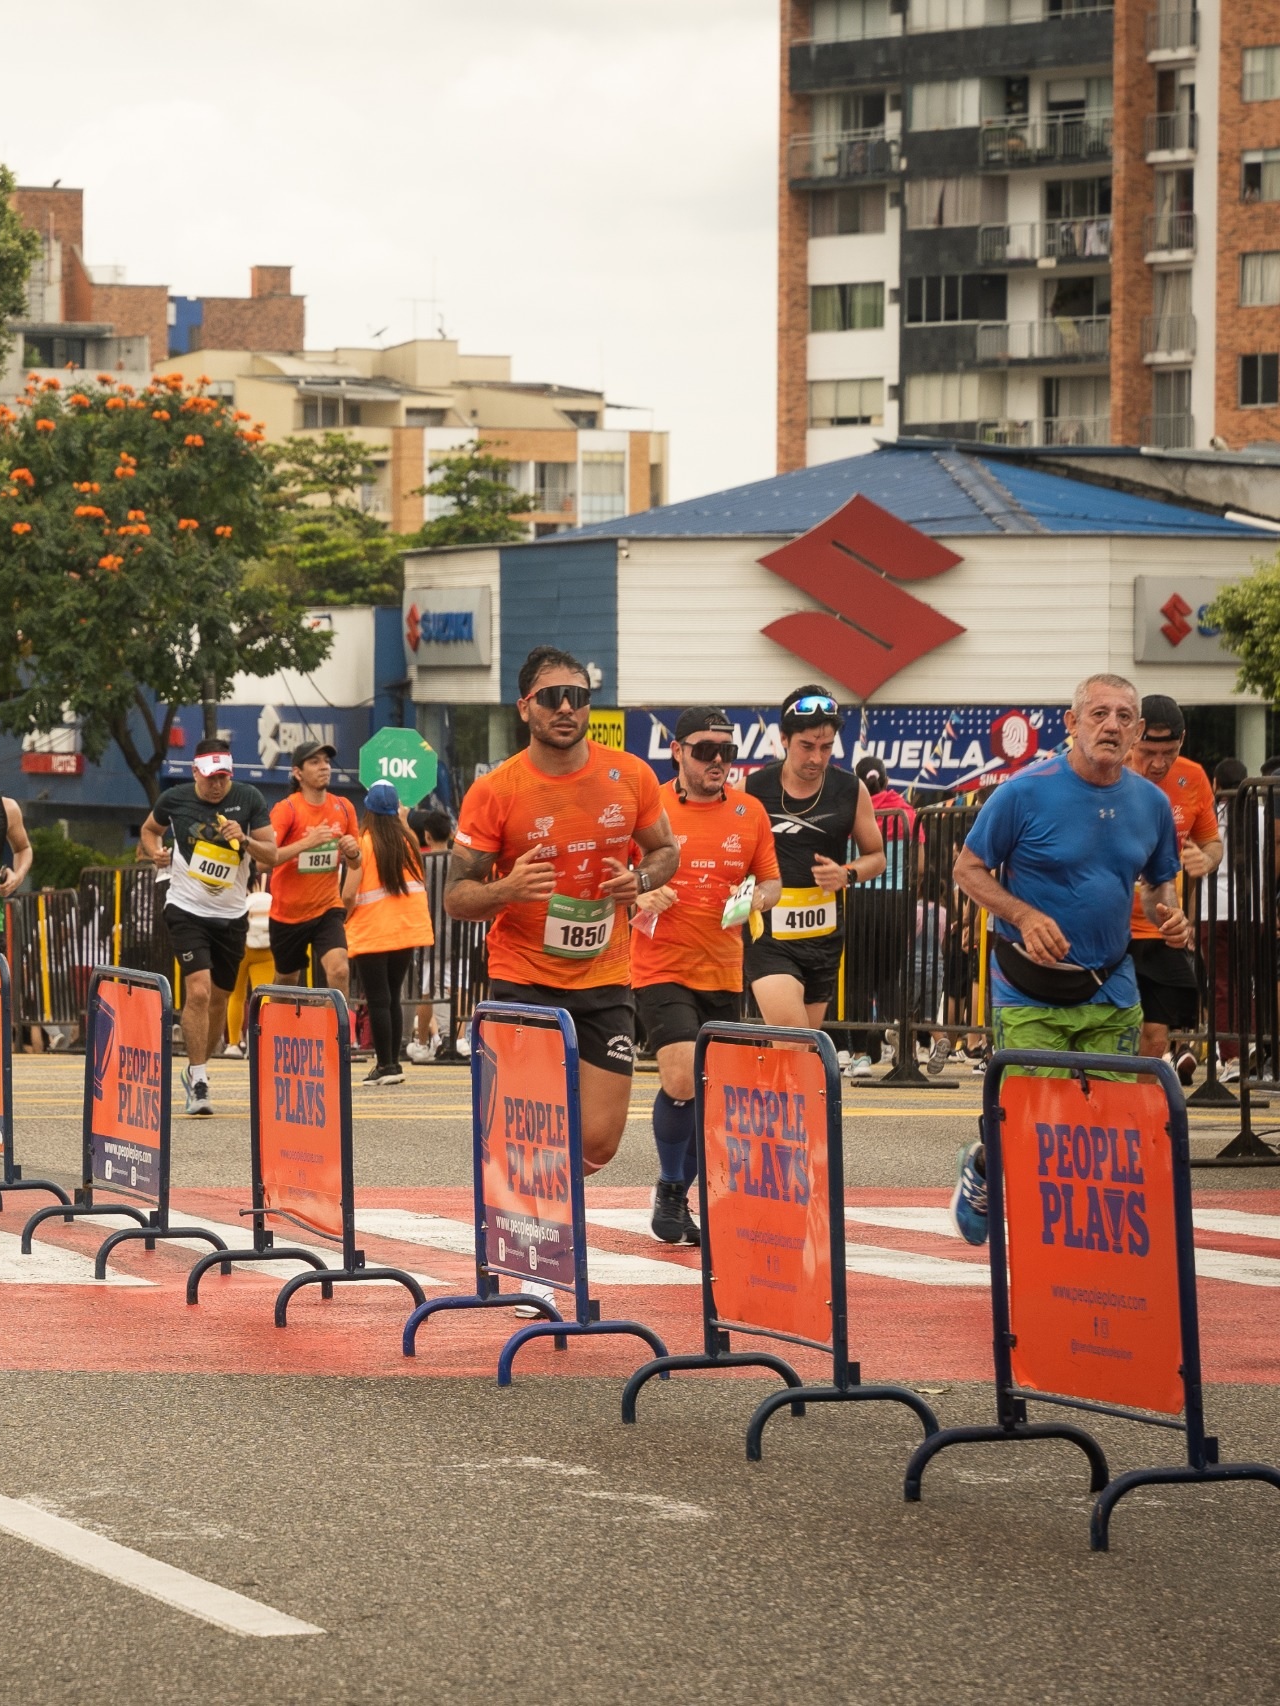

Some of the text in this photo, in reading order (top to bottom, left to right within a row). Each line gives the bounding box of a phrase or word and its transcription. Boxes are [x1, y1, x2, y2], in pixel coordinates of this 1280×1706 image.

[421, 611, 473, 641] SUZUKI
[648, 723, 786, 759] LVA
[851, 740, 985, 769] HUELLA
[378, 757, 418, 779] 10K
[199, 860, 230, 879] 4007
[309, 854, 331, 867] 1874
[560, 923, 607, 947] 1850
[785, 908, 826, 929] 4100
[118, 1045, 160, 1087] PEOPLE
[274, 1036, 324, 1077] PEOPLE
[118, 1082, 160, 1132] PLAYS
[274, 1076, 326, 1128] PLAYS
[724, 1084, 807, 1143] PEOPLE
[504, 1096, 566, 1148] PEOPLE
[105, 1142, 152, 1165] www.peopleplays.com
[726, 1136, 809, 1206] PLAYS
[1035, 1123, 1144, 1185] PEOPLE
[506, 1142, 568, 1203] PLAYS
[496, 1215, 560, 1245] www.peopleplays.com
[1040, 1182, 1151, 1258] PLAYS
[1051, 1285, 1147, 1312] www.peopleplays.com
